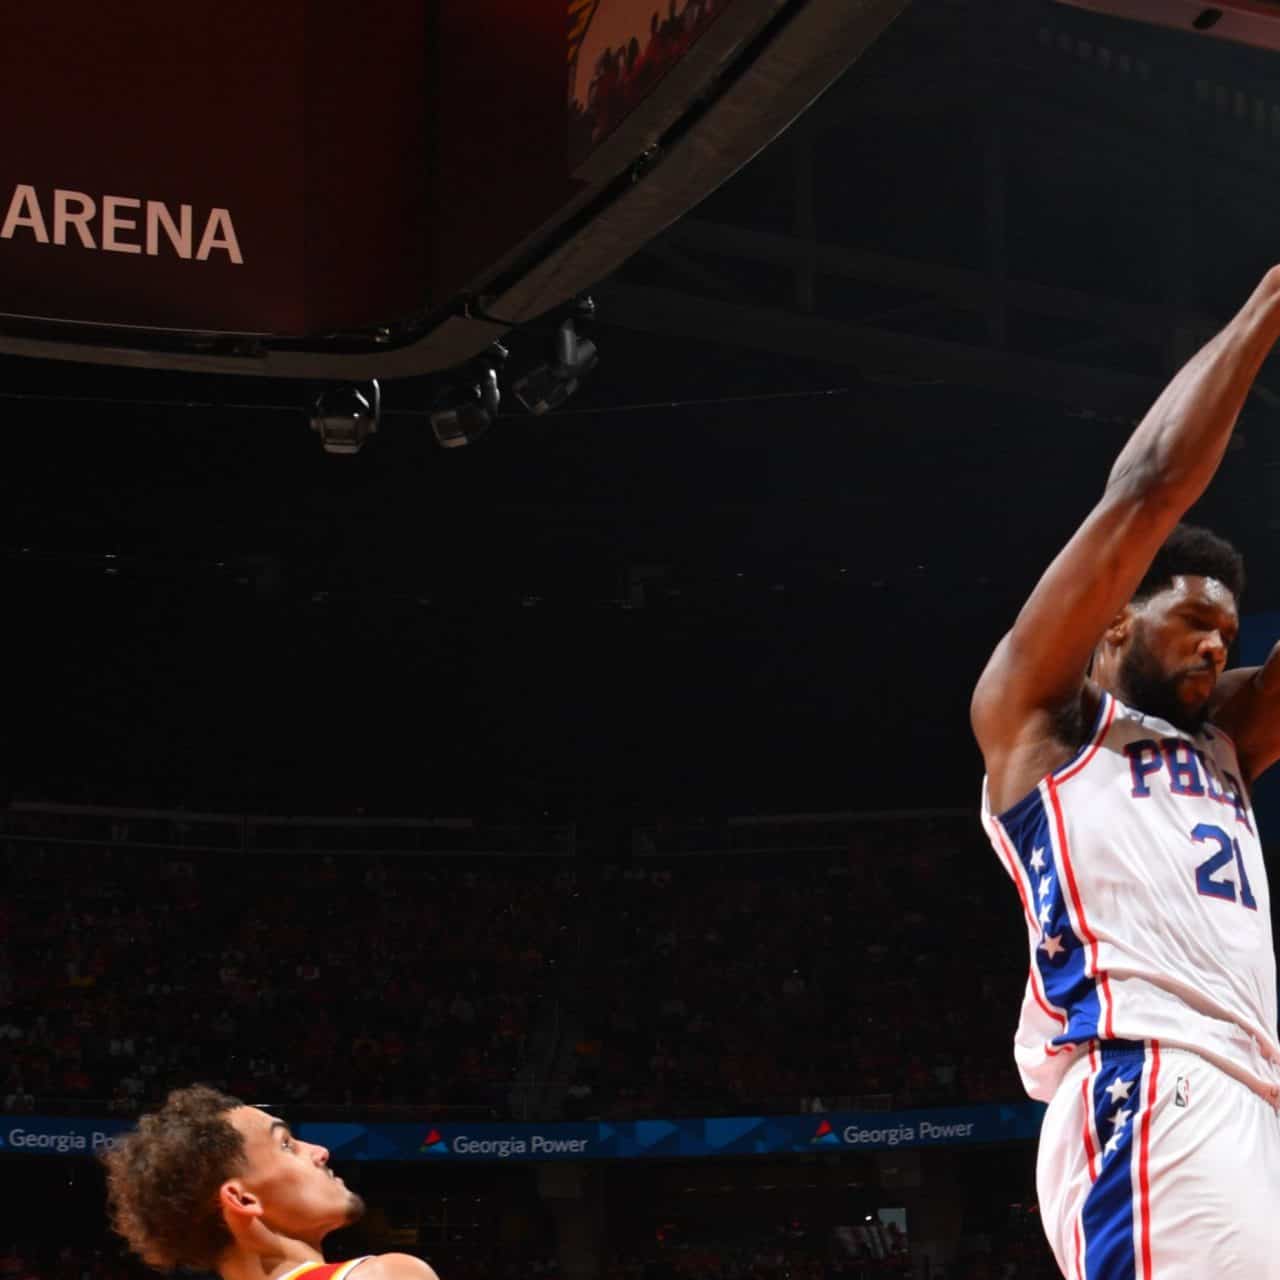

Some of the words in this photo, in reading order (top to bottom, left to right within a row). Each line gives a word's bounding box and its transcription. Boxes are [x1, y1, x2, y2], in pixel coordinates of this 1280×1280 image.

[0, 183, 244, 265] ARENA
[1190, 822, 1258, 912] 21
[8, 1128, 87, 1153] Georgia
[453, 1135, 527, 1157] Georgia
[531, 1135, 588, 1153] Power
[843, 1123, 916, 1146] Georgia
[919, 1121, 975, 1140] Power
